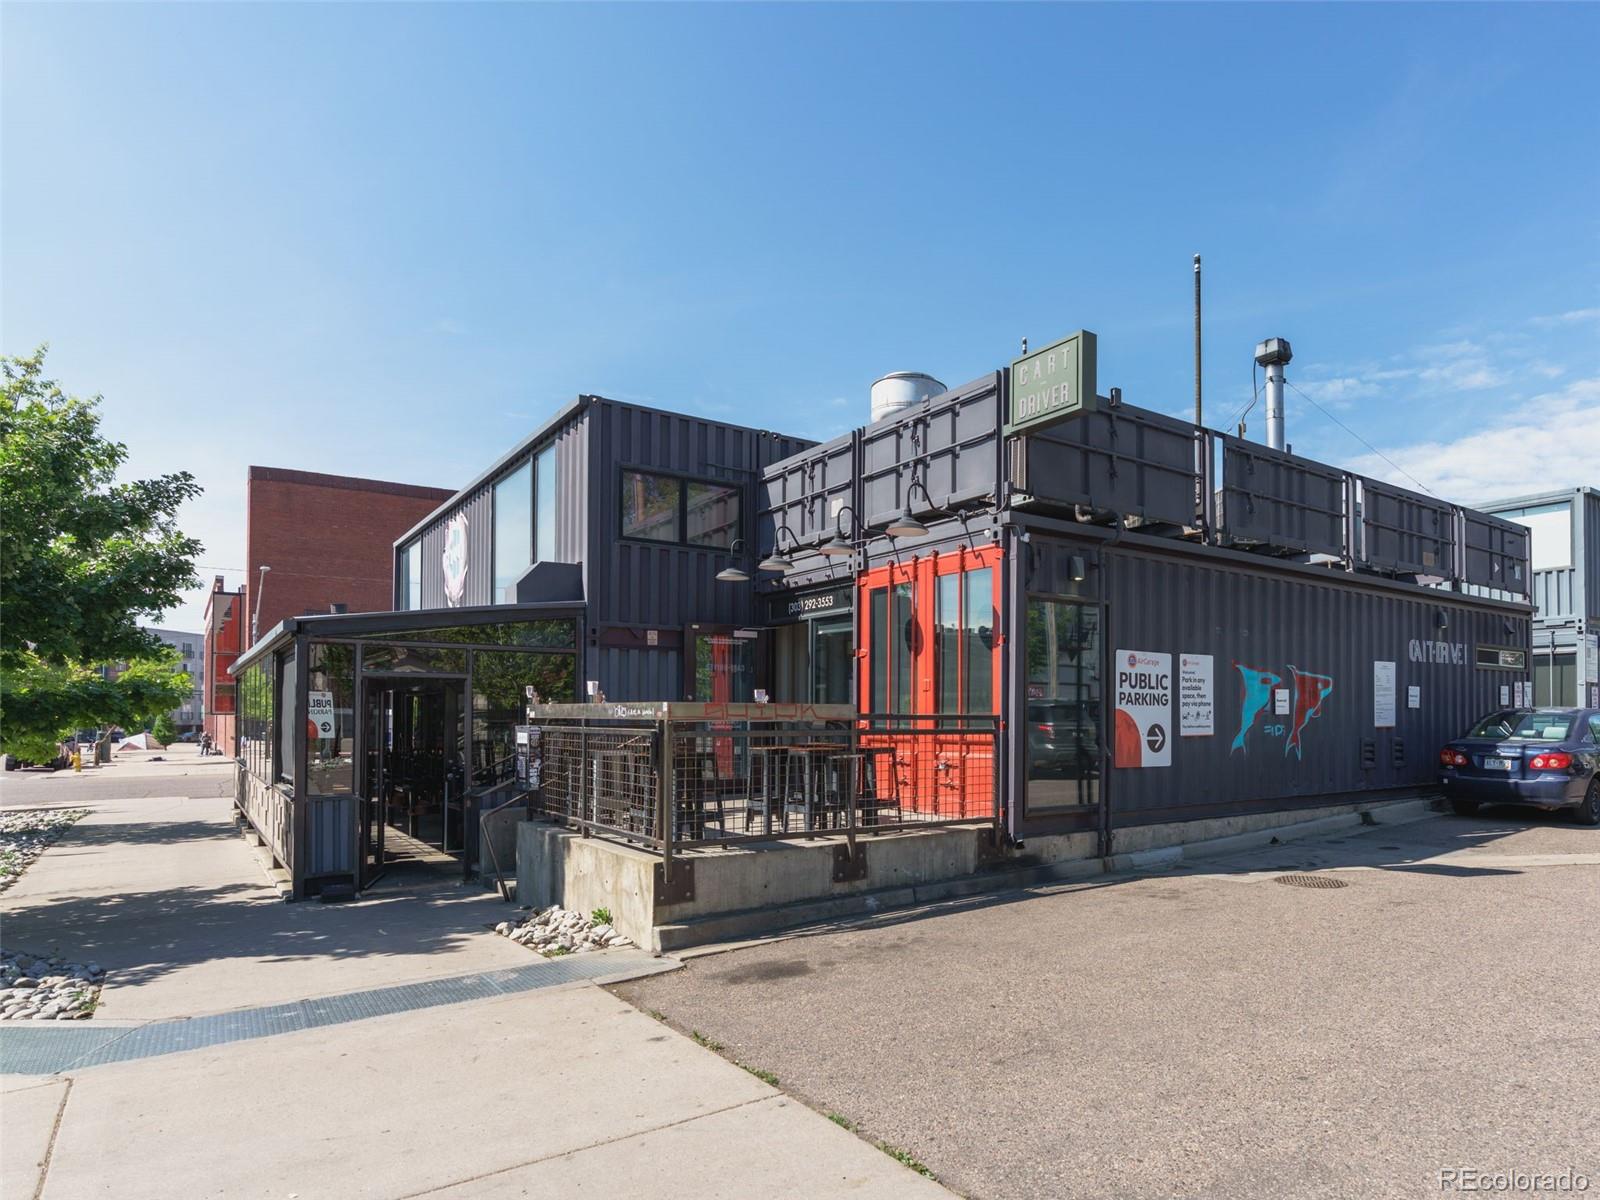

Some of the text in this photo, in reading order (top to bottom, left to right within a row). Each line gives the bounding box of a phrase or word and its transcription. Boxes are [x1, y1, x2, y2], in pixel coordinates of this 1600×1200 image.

[1019, 346, 1070, 386] CART
[1019, 382, 1069, 420] DRIVER
[804, 595, 833, 610] 292-3553
[1119, 672, 1169, 690] PUBLIC
[1119, 692, 1169, 707] PARKING
